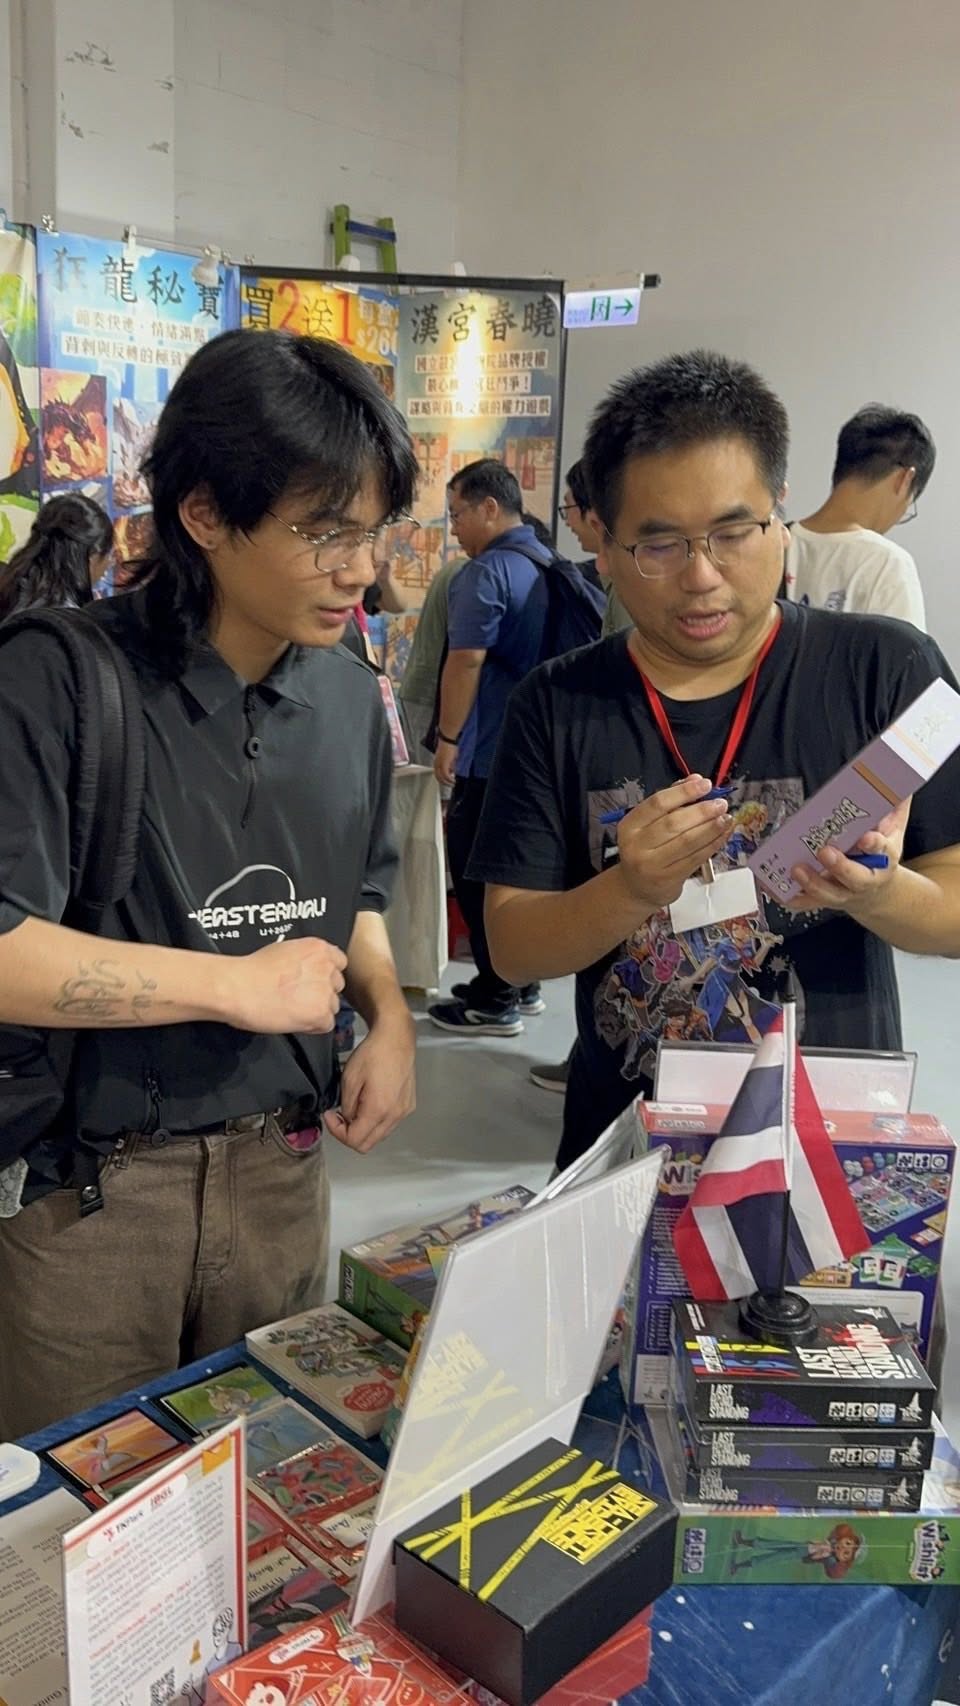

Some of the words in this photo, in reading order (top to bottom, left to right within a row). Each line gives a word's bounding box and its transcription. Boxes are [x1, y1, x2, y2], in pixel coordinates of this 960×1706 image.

[411, 296, 556, 344] 漢宮春曉
[795, 1346, 840, 1378] LAST
[827, 1345, 873, 1379] HAND
[847, 1323, 905, 1379] STANDING
[710, 1384, 734, 1394] LAST
[709, 1404, 750, 1420] STANDING
[917, 1522, 937, 1579] Wishlist
